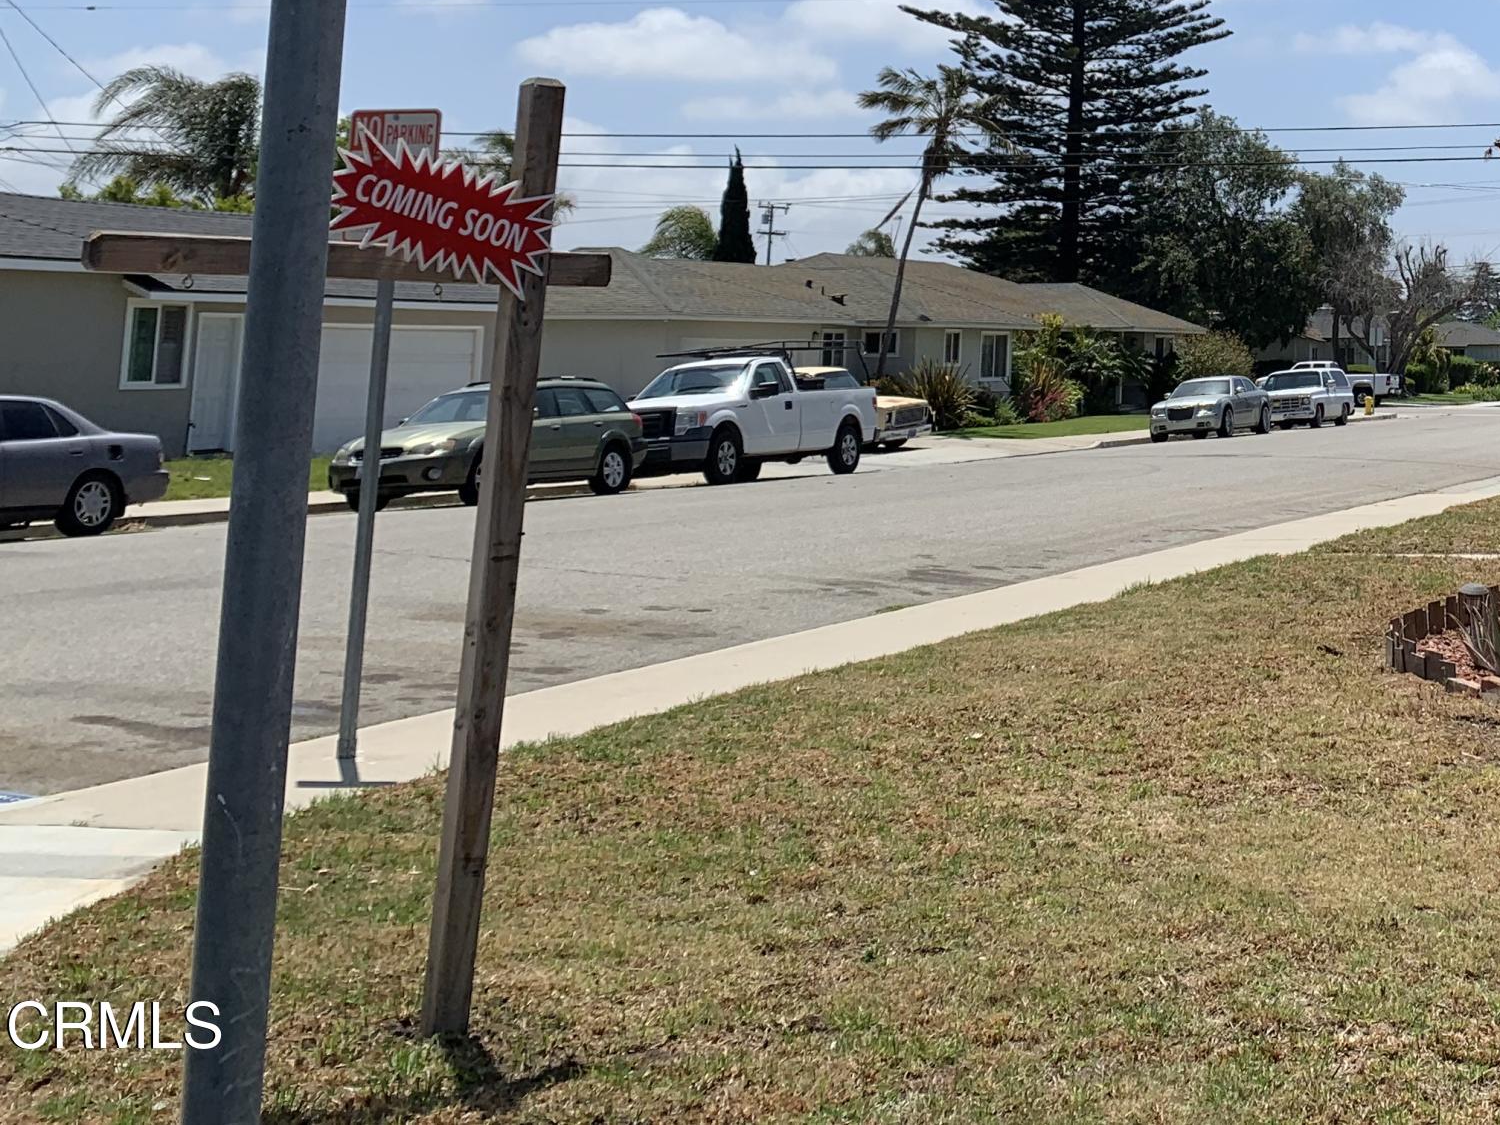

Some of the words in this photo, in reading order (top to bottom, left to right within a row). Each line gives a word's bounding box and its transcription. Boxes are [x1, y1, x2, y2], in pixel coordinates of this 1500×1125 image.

[386, 124, 434, 146] PARKING
[355, 174, 459, 230] COMING
[458, 208, 529, 253] SOON
